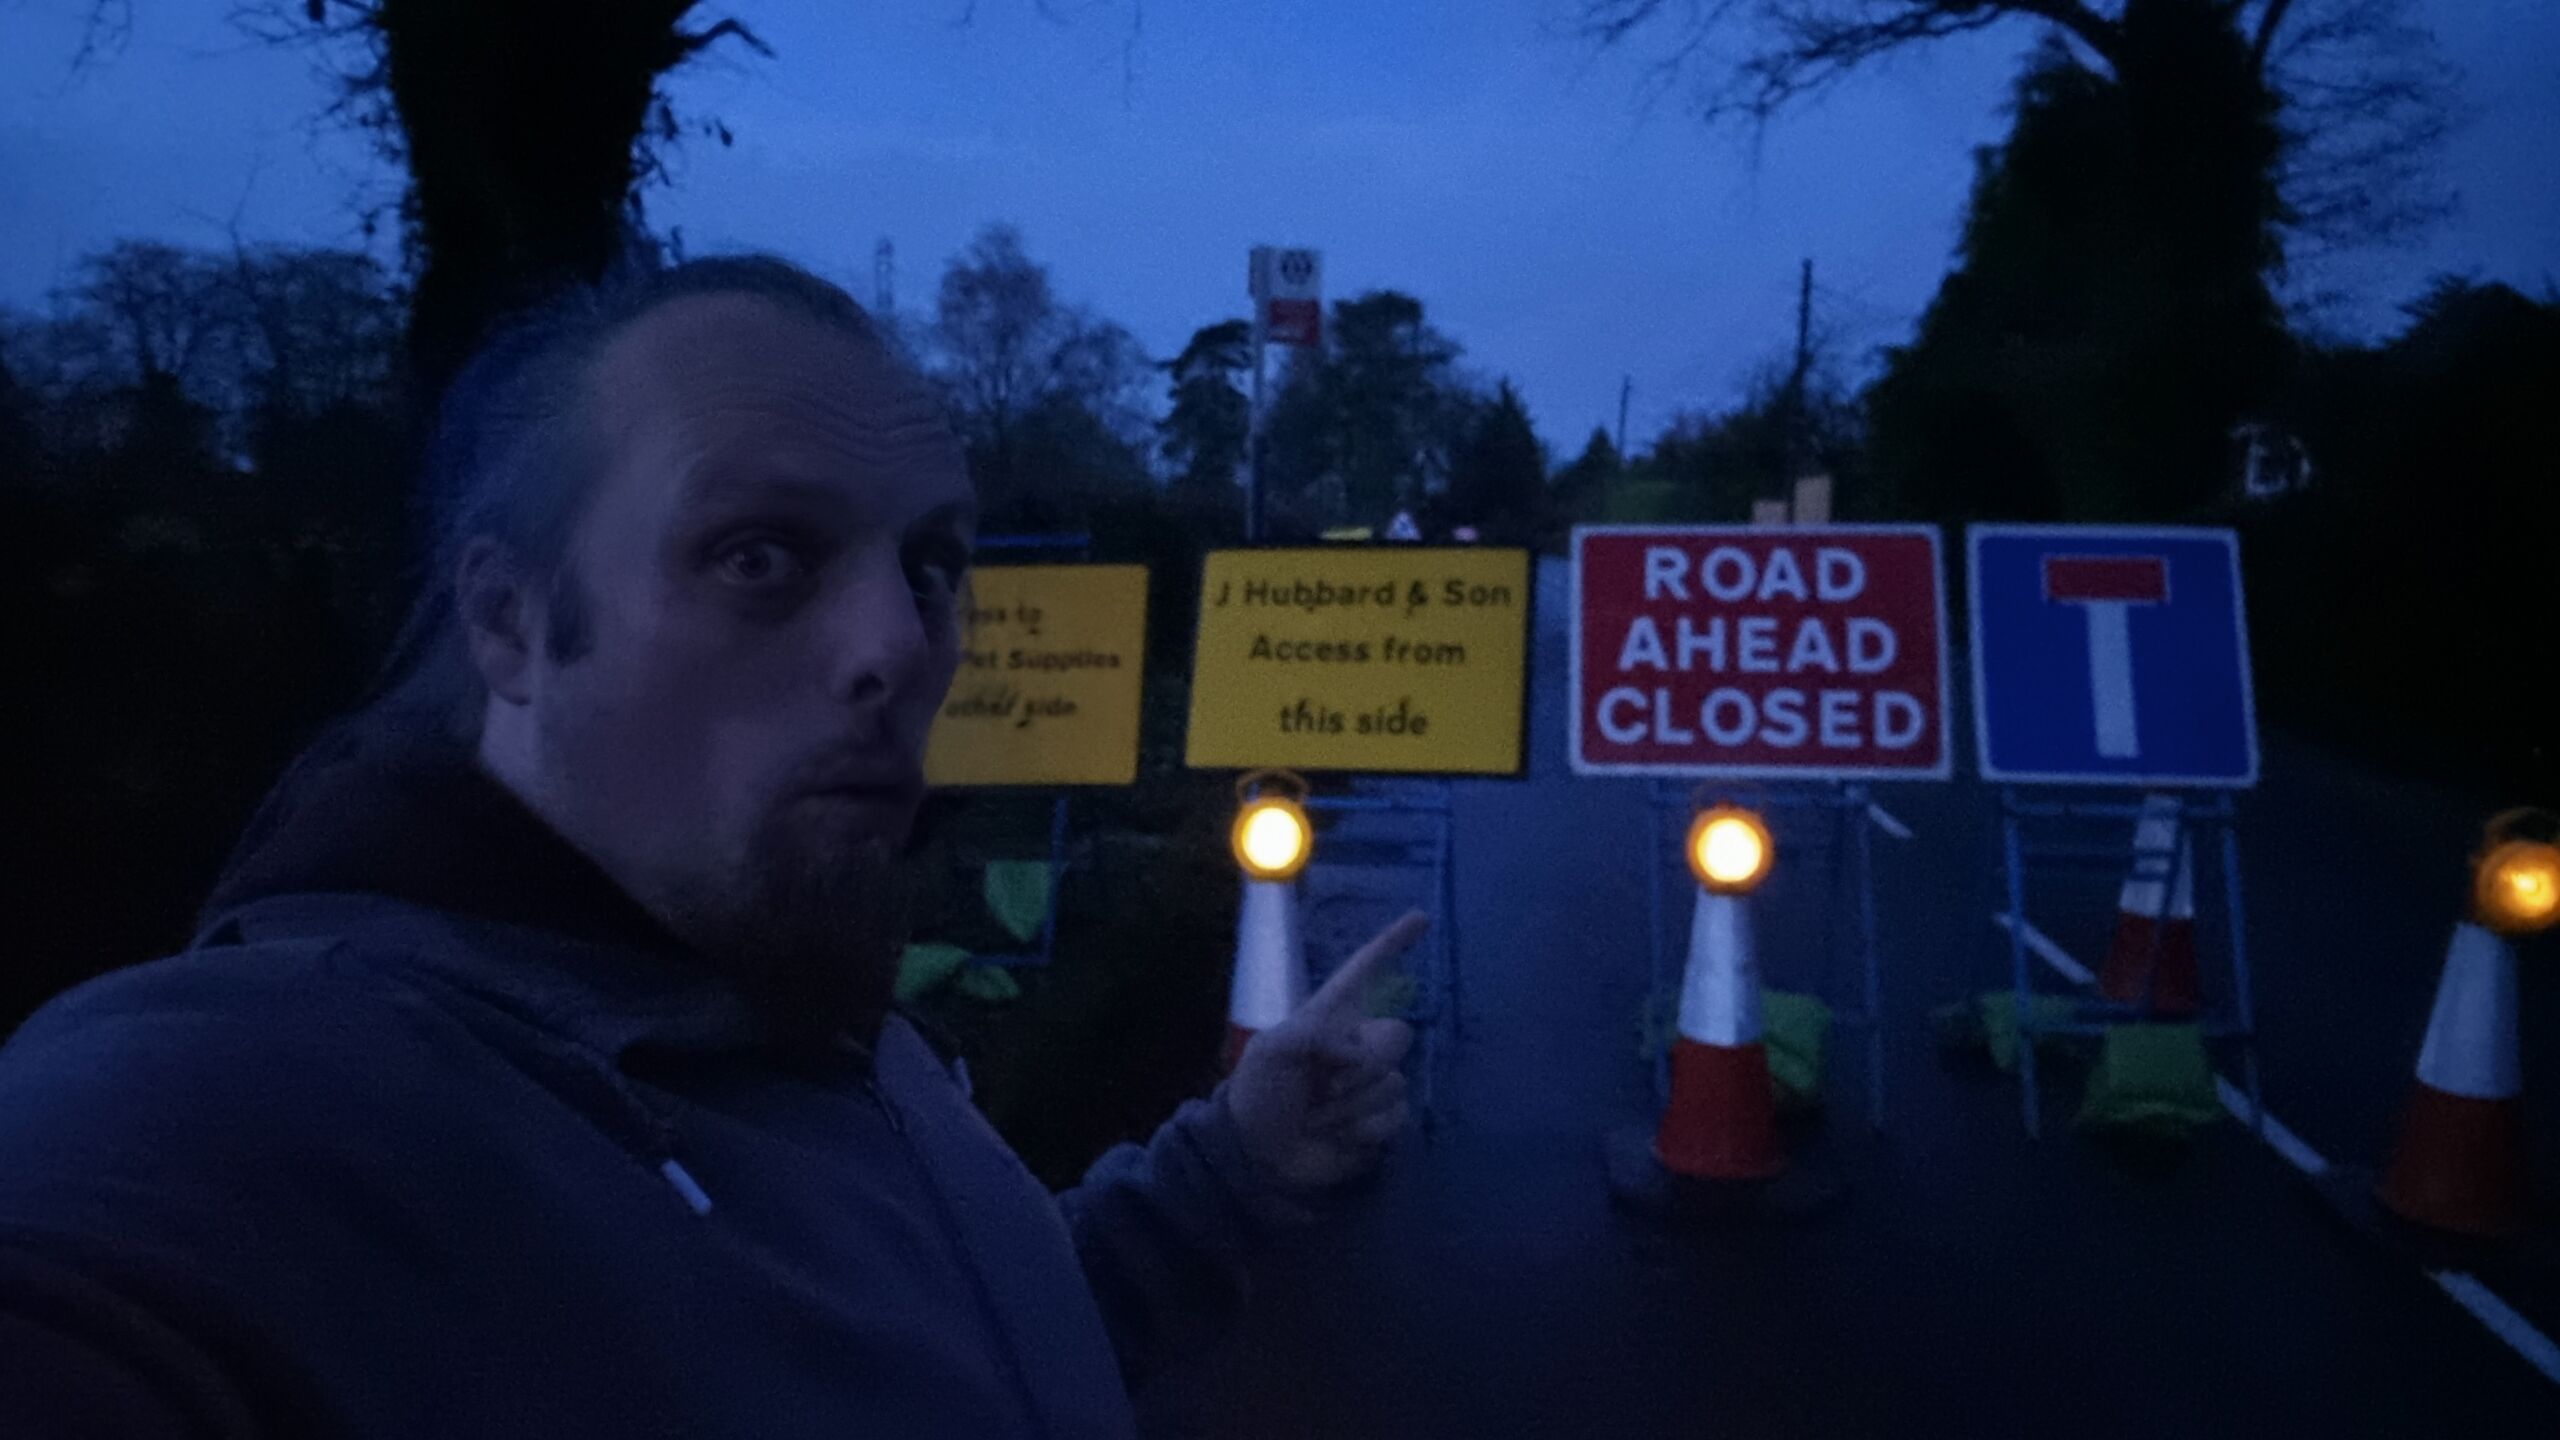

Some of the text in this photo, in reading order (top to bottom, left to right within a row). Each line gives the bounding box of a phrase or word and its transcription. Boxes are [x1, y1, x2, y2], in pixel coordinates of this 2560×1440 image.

[1644, 545, 1867, 601] ROAD
[1216, 578, 1512, 608] J Hubbard & Son
[1007, 650, 1121, 670] Supplies
[1250, 635, 1467, 664] Access from
[1617, 615, 1898, 673] AHEAD
[1026, 698, 1077, 717] side
[1280, 697, 1429, 734] this side
[1597, 686, 1927, 749] CLOSED
